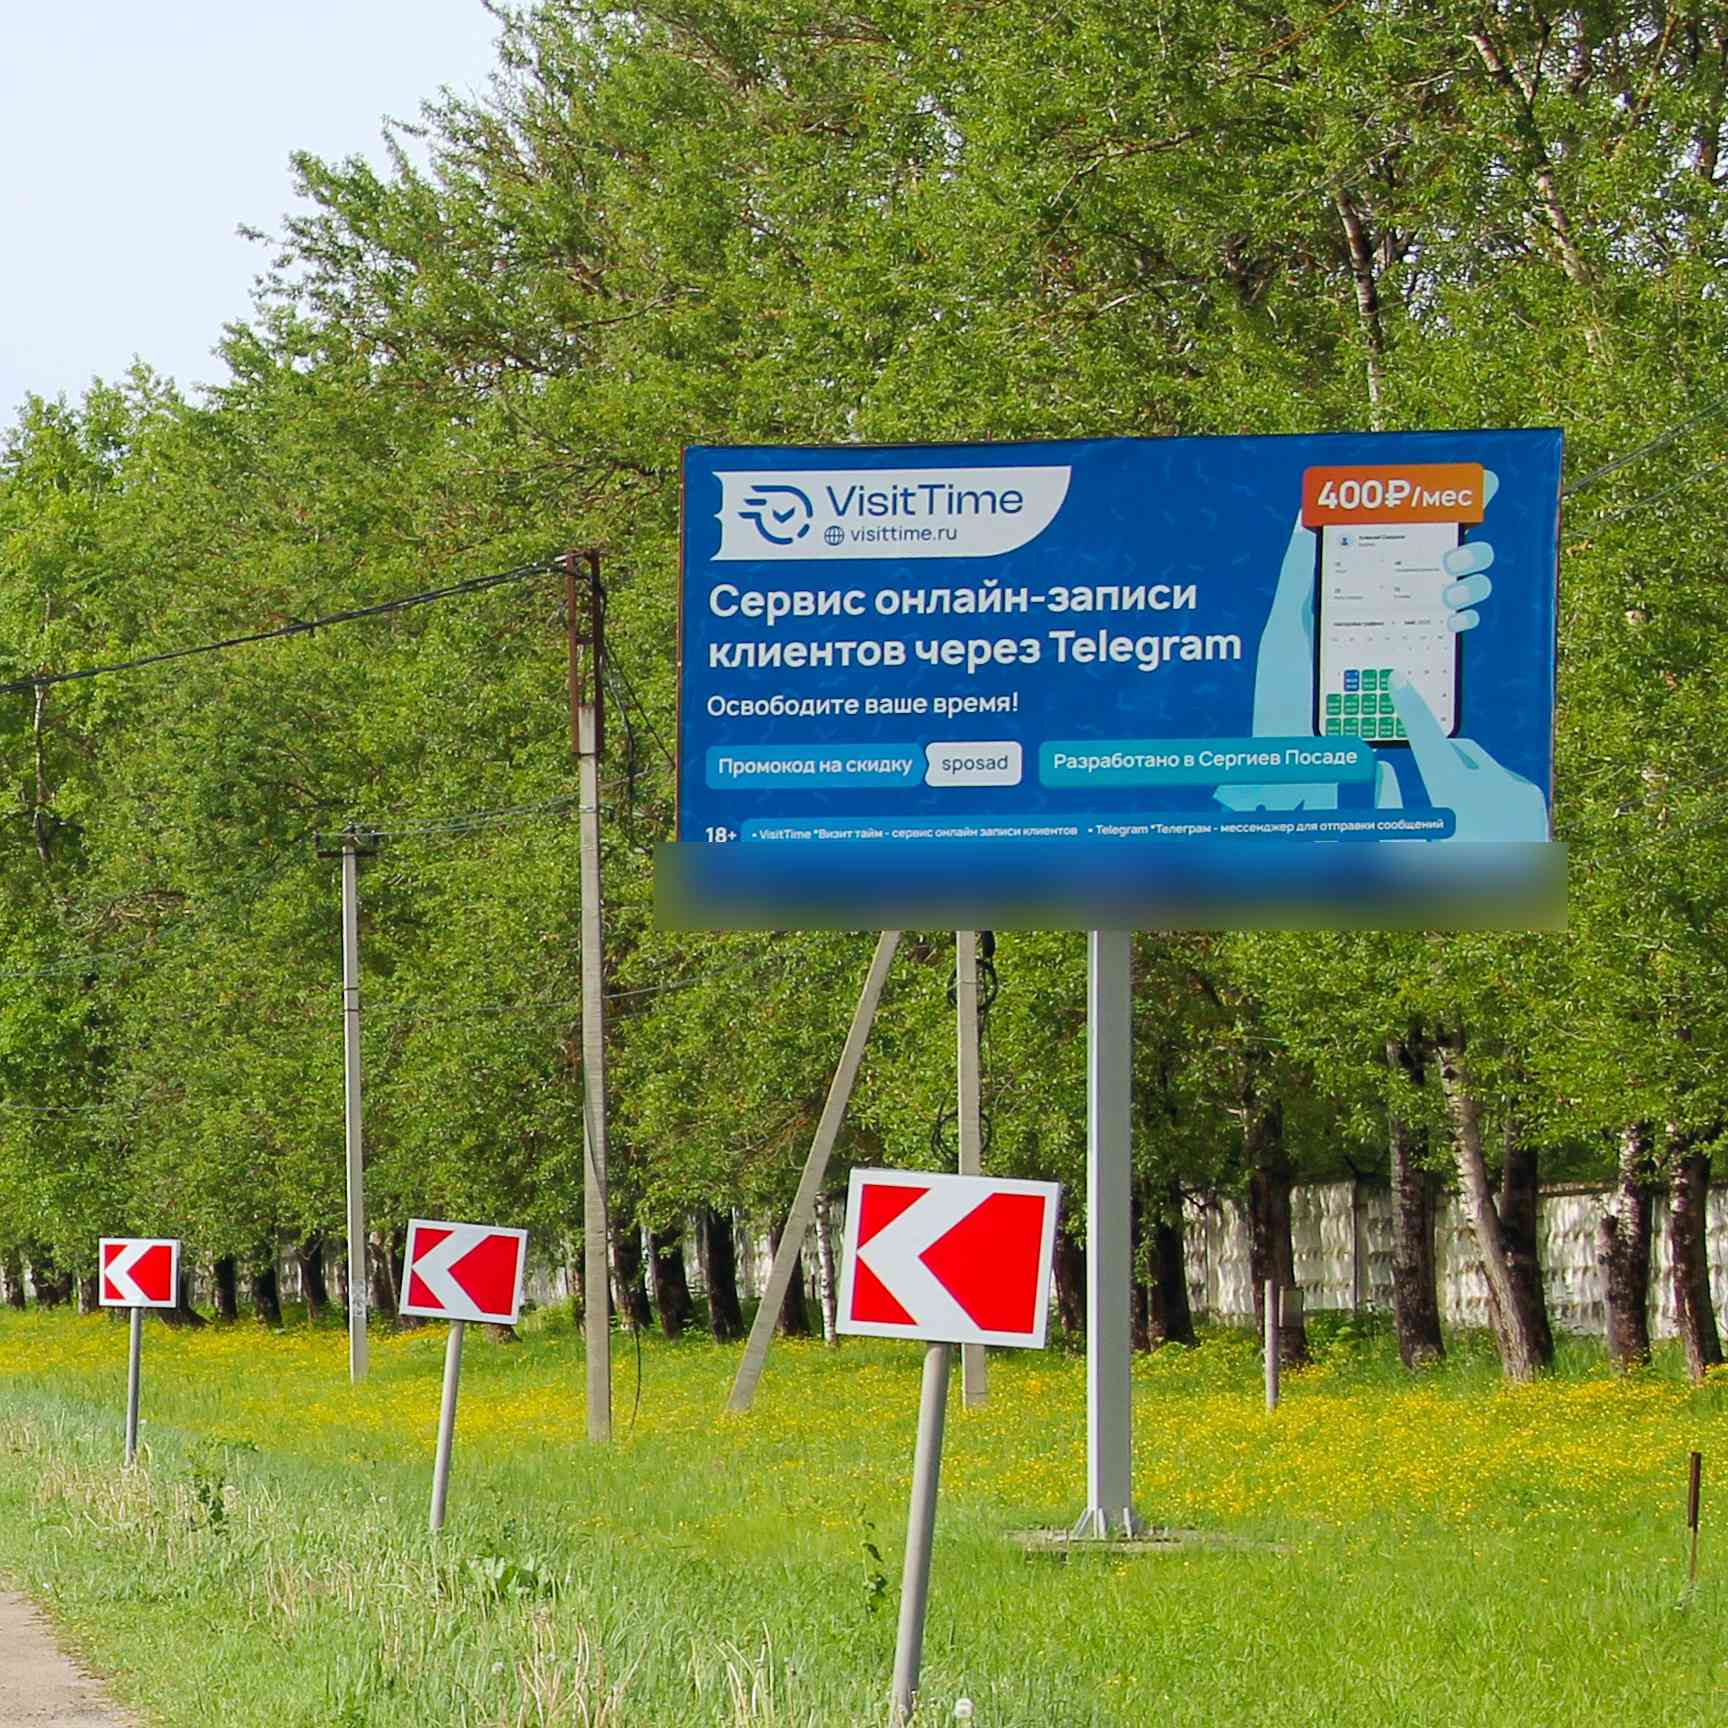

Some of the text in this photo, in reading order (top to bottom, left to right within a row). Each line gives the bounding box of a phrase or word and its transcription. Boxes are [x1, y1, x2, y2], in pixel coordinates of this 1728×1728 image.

[825, 482, 1024, 517] VisitTime
[1317, 479, 1473, 510] 400₽/мес
[850, 526, 958, 544] visittime.ru
[709, 578, 1197, 627] Сервис онлайн-записи
[709, 628, 1242, 674] клиентов через Telegram
[707, 692, 1019, 719] Освободите ваше время!
[718, 758, 913, 778] Промокод на скидку
[941, 755, 1009, 775] sposad
[1053, 748, 1358, 773] Разработано в Сергиев Посаде
[705, 826, 737, 843] 18+
